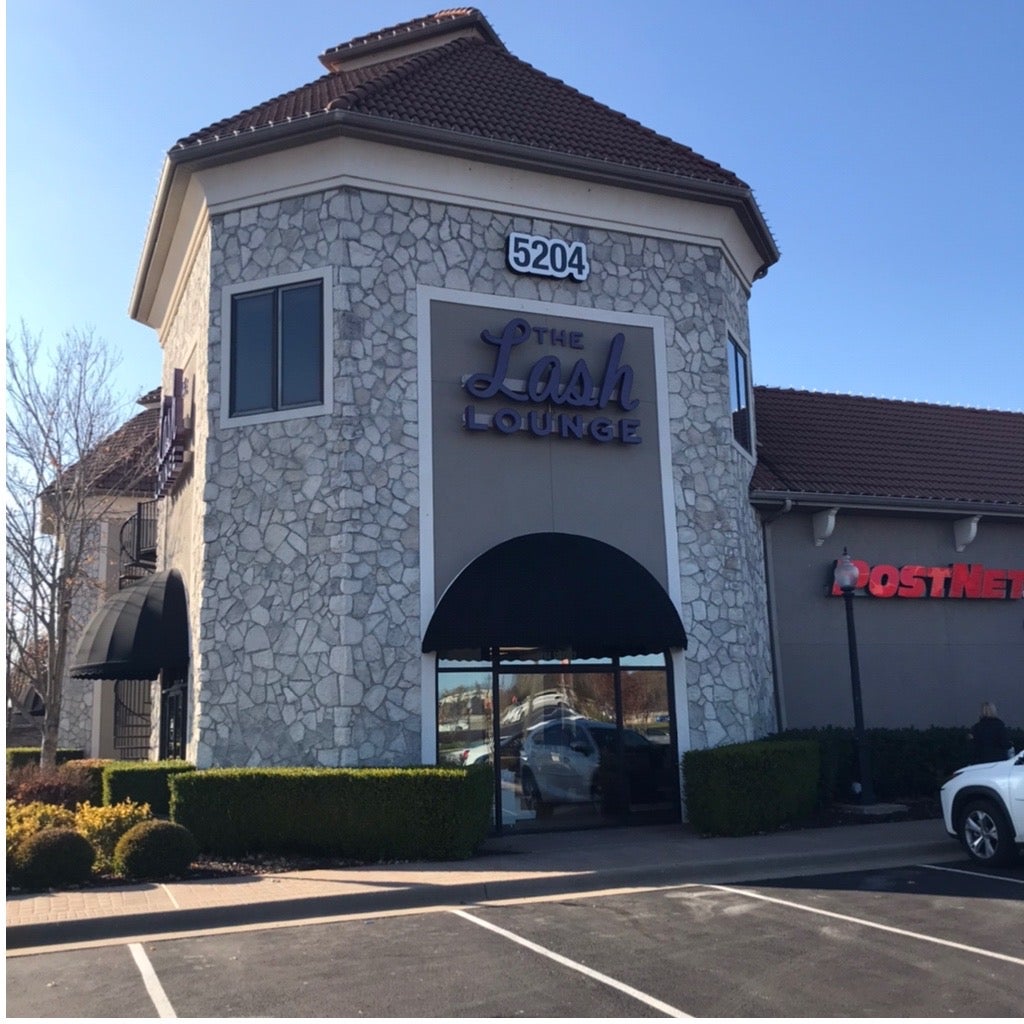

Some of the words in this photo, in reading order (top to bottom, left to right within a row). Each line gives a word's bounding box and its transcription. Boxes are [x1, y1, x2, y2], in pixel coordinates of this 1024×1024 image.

[512, 236, 587, 276] 5204
[532, 326, 585, 350] THE
[464, 317, 640, 412] Lash
[464, 404, 642, 445] LOUNGE
